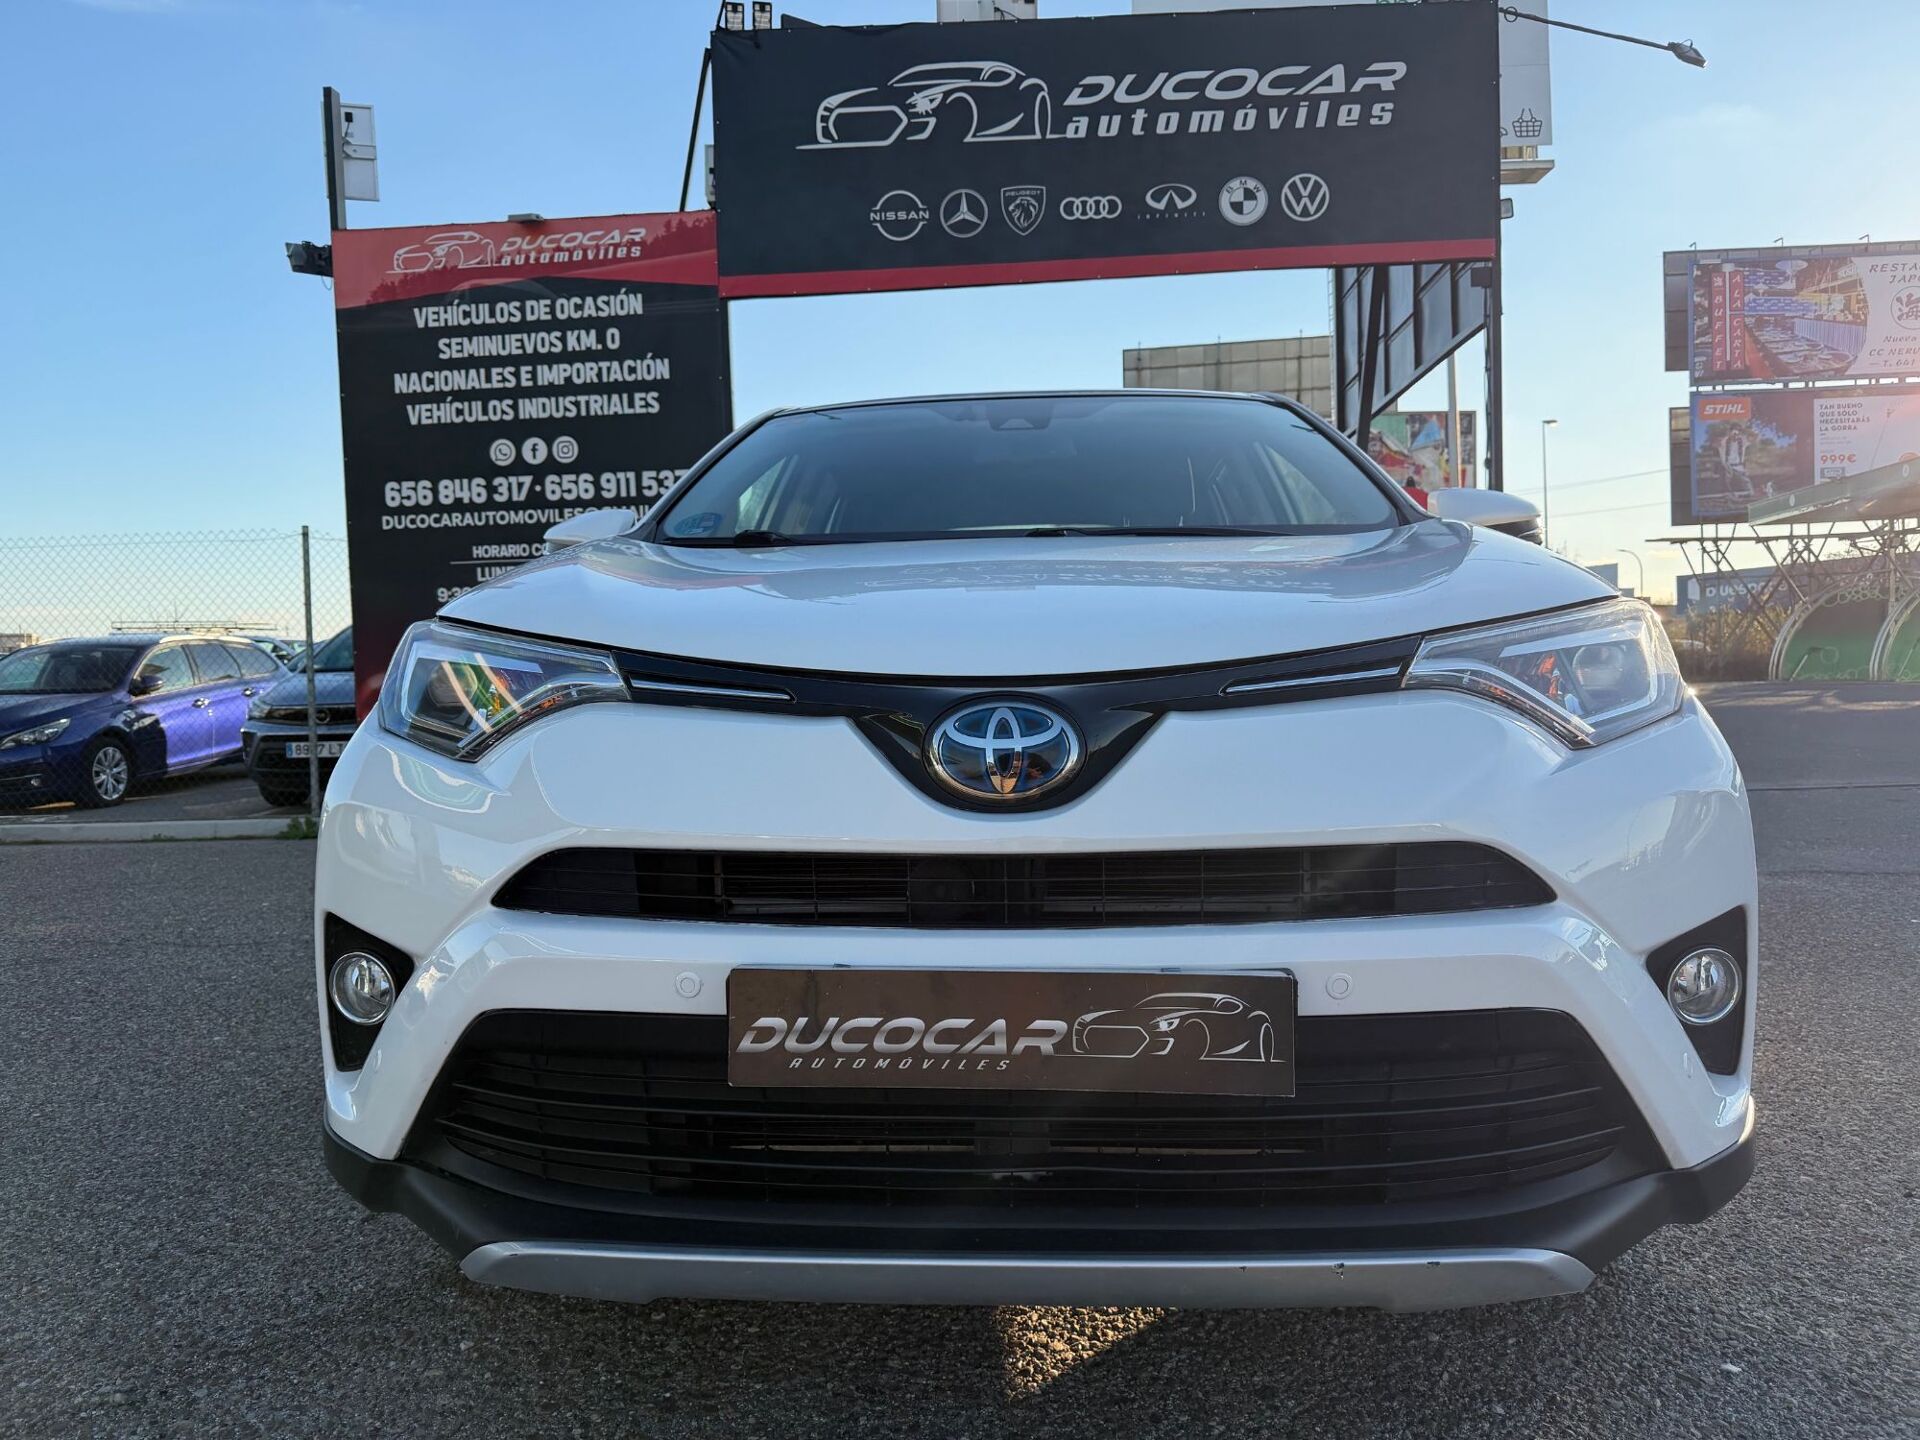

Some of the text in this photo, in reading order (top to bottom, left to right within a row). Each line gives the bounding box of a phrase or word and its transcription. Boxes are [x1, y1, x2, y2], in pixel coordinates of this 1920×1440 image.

[1062, 61, 1408, 106] DUCOCAR
[1065, 100, 1394, 139] automóviles
[870, 210, 930, 221] NISSAN
[500, 227, 647, 251] DUCOCAR
[1869, 262, 1920, 274] RESTA
[414, 288, 643, 328] VEHÍCULOS DE OCASIÓN
[438, 331, 562, 360] SEMINUEVOS
[567, 328, 602, 351] KM.
[394, 352, 670, 394] NACIONALES E IMPORTACIÓN
[406, 391, 660, 425] VEHÍCULOS INDUSTRIALES
[1703, 404, 1745, 415] STIHL
[1820, 453, 1857, 465] 999€
[384, 480, 434, 507] 656
[438, 477, 487, 504] 846
[601, 471, 637, 498] 911
[472, 543, 530, 558] HORARIO
[476, 566, 516, 582] LUN
[736, 1016, 1067, 1056] DUCOCAR
[788, 1056, 1011, 1071] AUTOMÓVILES
